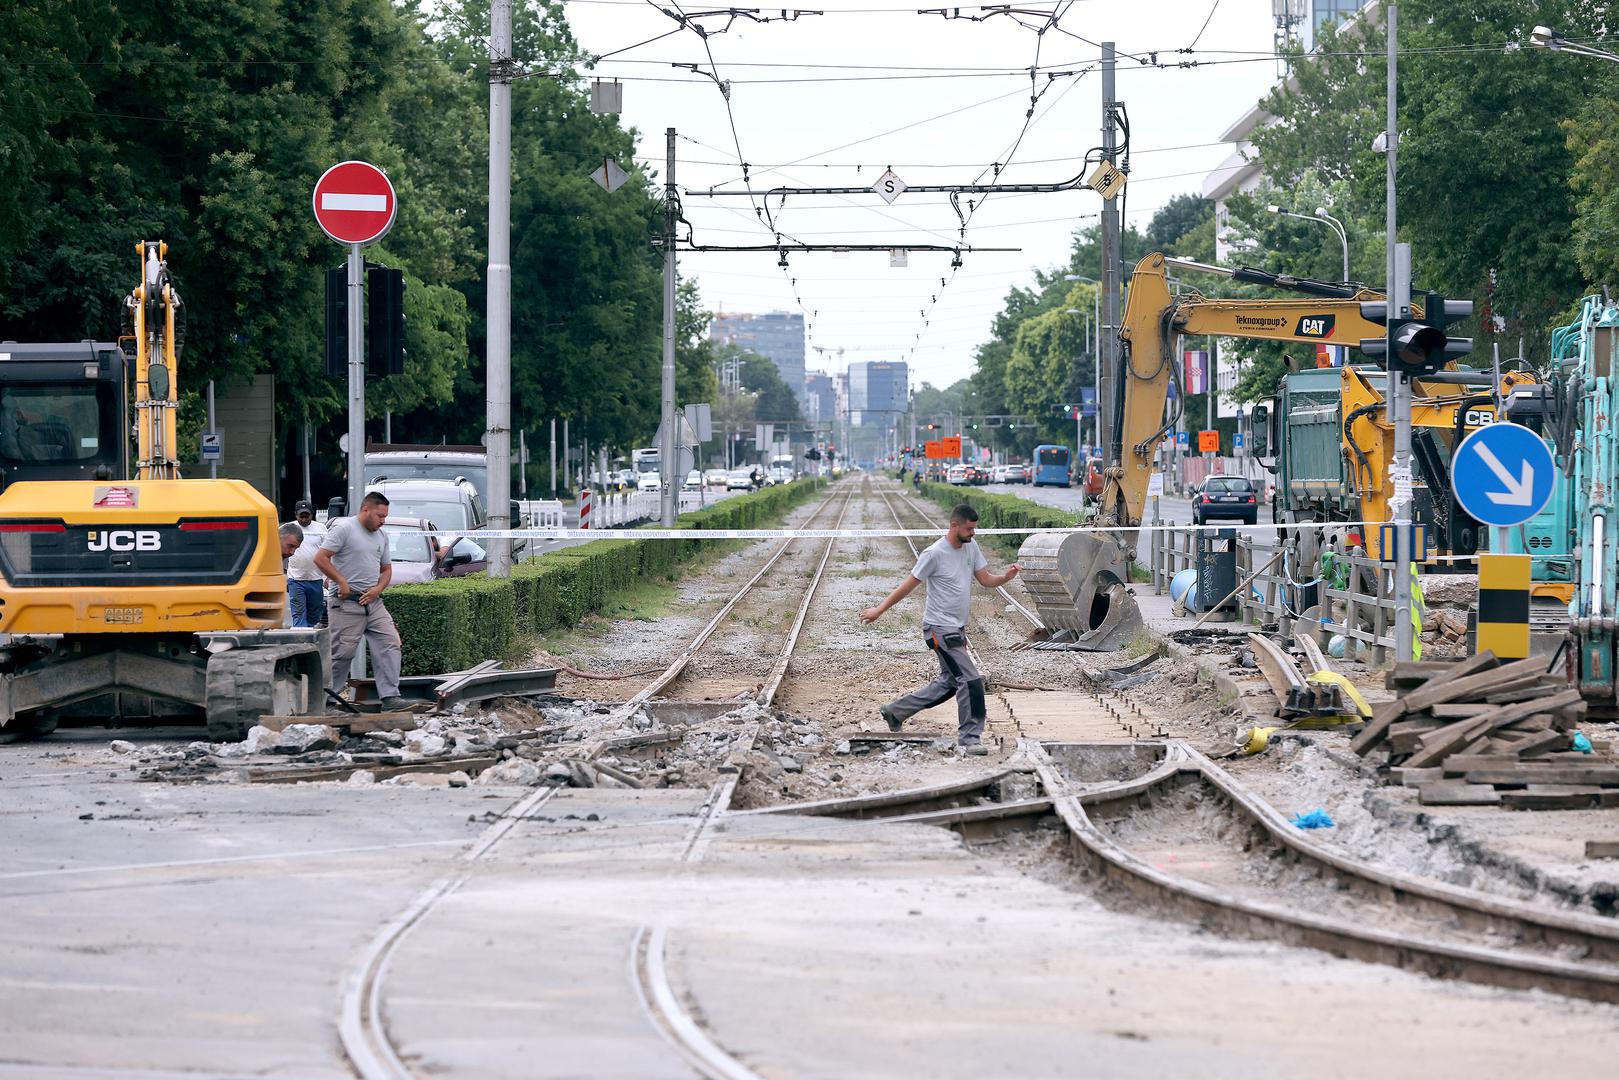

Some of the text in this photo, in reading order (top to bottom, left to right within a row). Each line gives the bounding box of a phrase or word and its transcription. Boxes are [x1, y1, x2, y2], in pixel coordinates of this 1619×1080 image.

[884, 180, 895, 193] S
[1235, 315, 1280, 327] Teknoxgroup
[1302, 318, 1325, 335] CAT
[1453, 409, 1494, 426] CB
[1180, 433, 1186, 442] P
[1236, 437, 1241, 447] P
[87, 531, 162, 551] JCB
